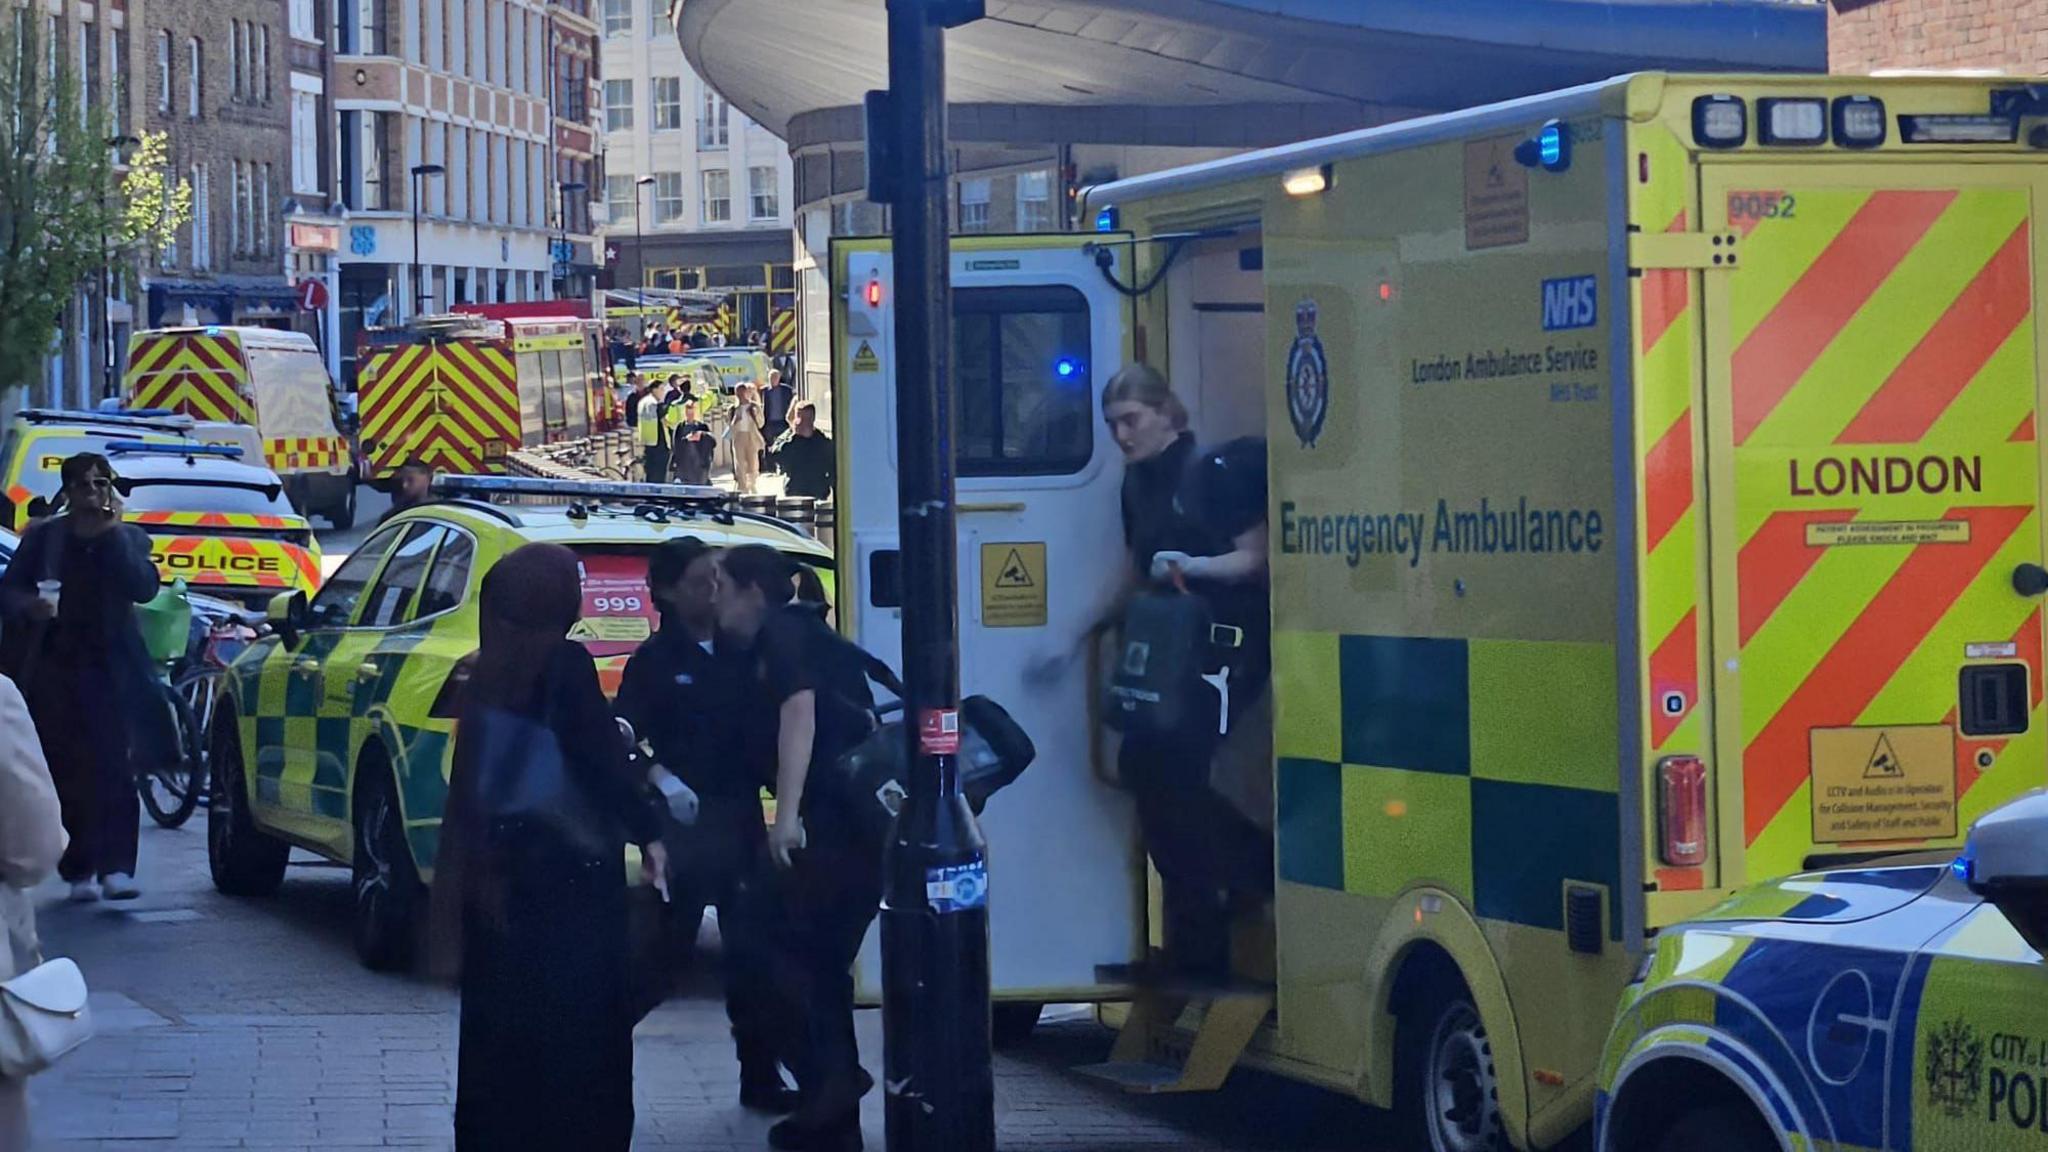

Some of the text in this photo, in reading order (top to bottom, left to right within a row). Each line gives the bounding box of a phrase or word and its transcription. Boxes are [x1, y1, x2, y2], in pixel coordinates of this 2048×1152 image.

[1730, 195, 1795, 219] 9052
[1544, 279, 1594, 328] NHS
[1413, 342, 1597, 384] London Ambulance Service
[1789, 455, 1982, 496] LONDON
[1280, 497, 1603, 567] Emergency Ambulance
[593, 596, 642, 612] 999
[1991, 1032, 2028, 1061] CITY
